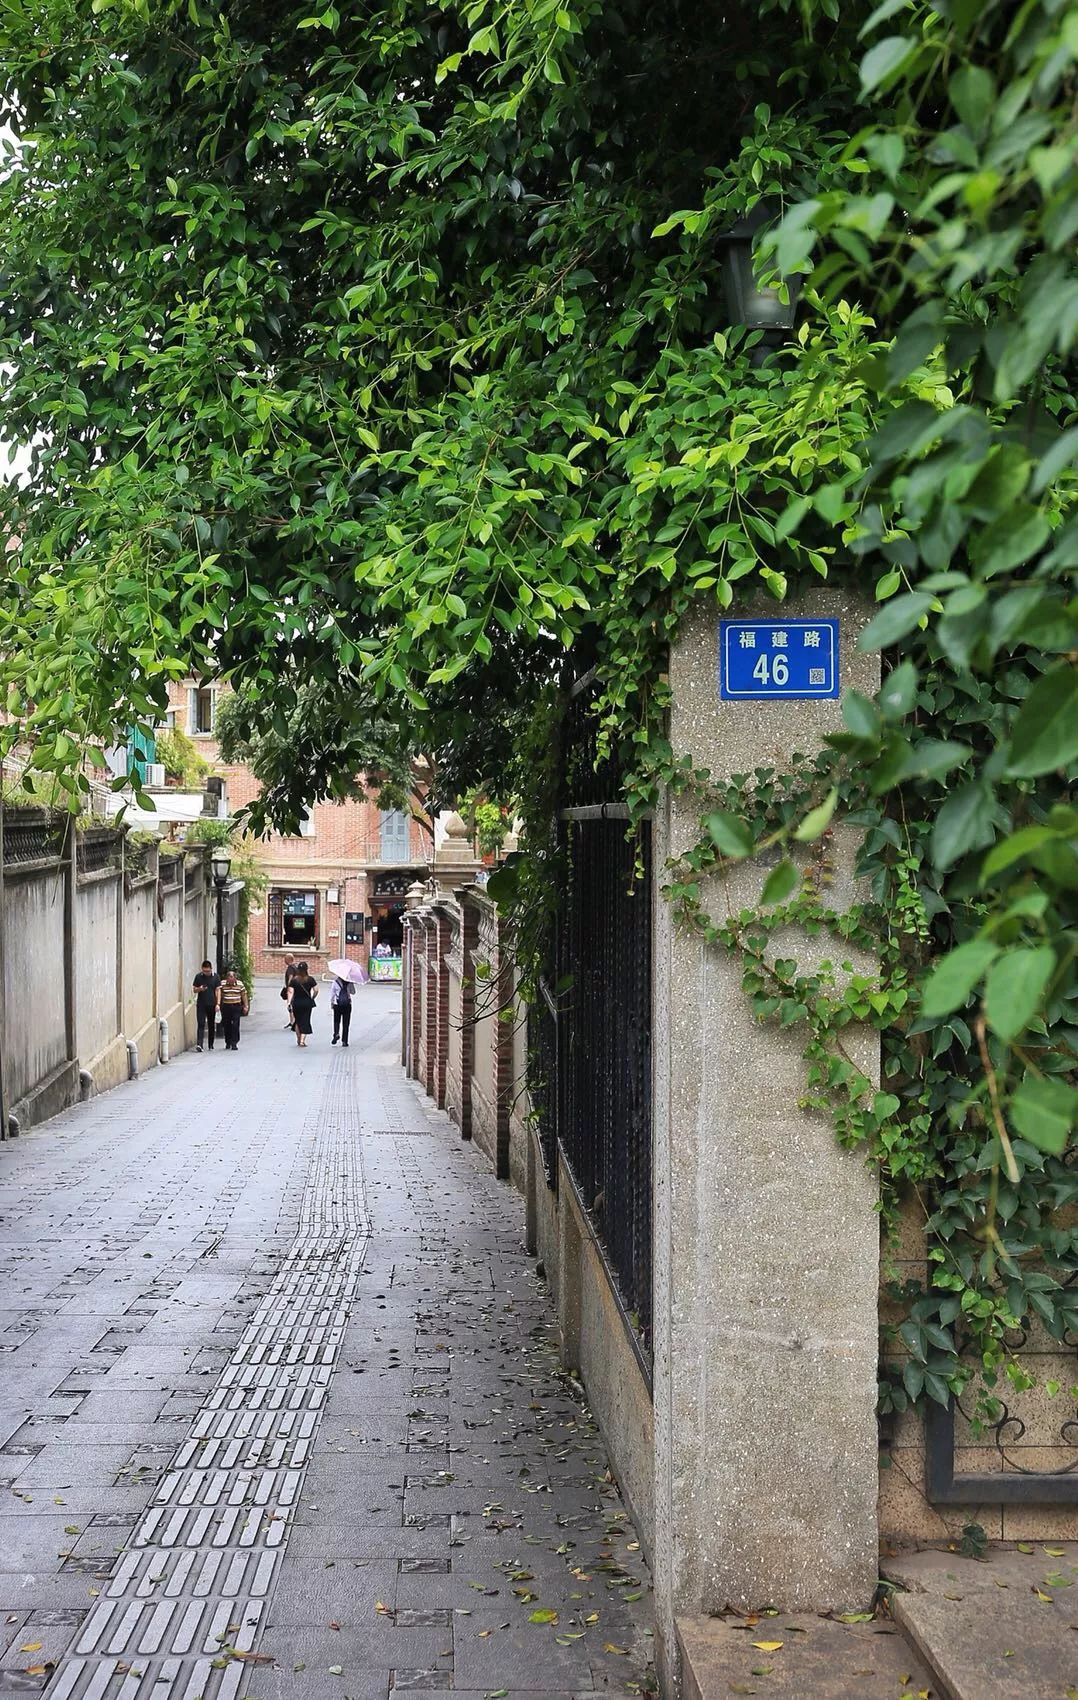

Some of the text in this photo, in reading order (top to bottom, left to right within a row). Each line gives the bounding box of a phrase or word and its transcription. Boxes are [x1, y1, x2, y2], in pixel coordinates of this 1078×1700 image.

[739, 631, 821, 648] 福建路
[753, 654, 789, 685] 46
